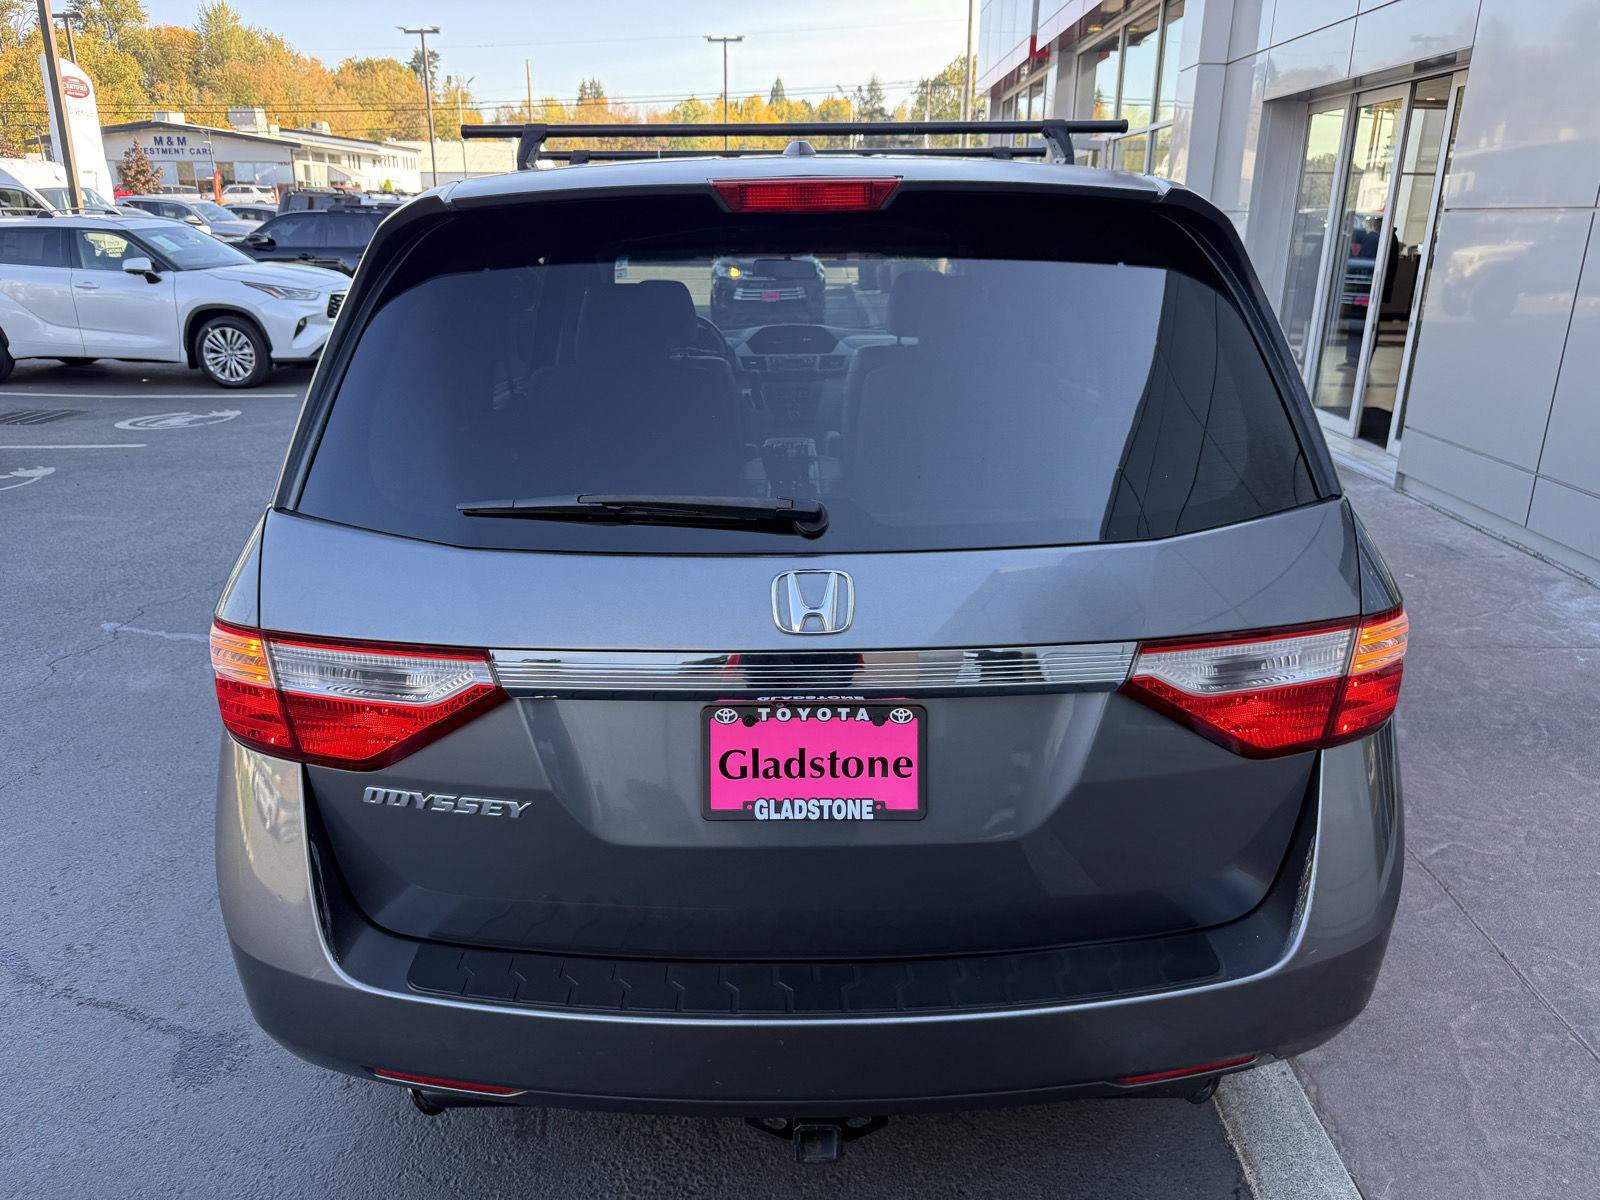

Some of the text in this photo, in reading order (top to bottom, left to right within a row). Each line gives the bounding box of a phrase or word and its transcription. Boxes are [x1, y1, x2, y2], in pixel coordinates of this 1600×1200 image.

[154, 136, 187, 146] M & M
[128, 147, 185, 155] INESTMENT
[757, 707, 870, 721] TOYOTA
[718, 747, 914, 780] Gladstone
[362, 786, 535, 818] ODYSSEY
[754, 799, 874, 820] GLADSTONE
